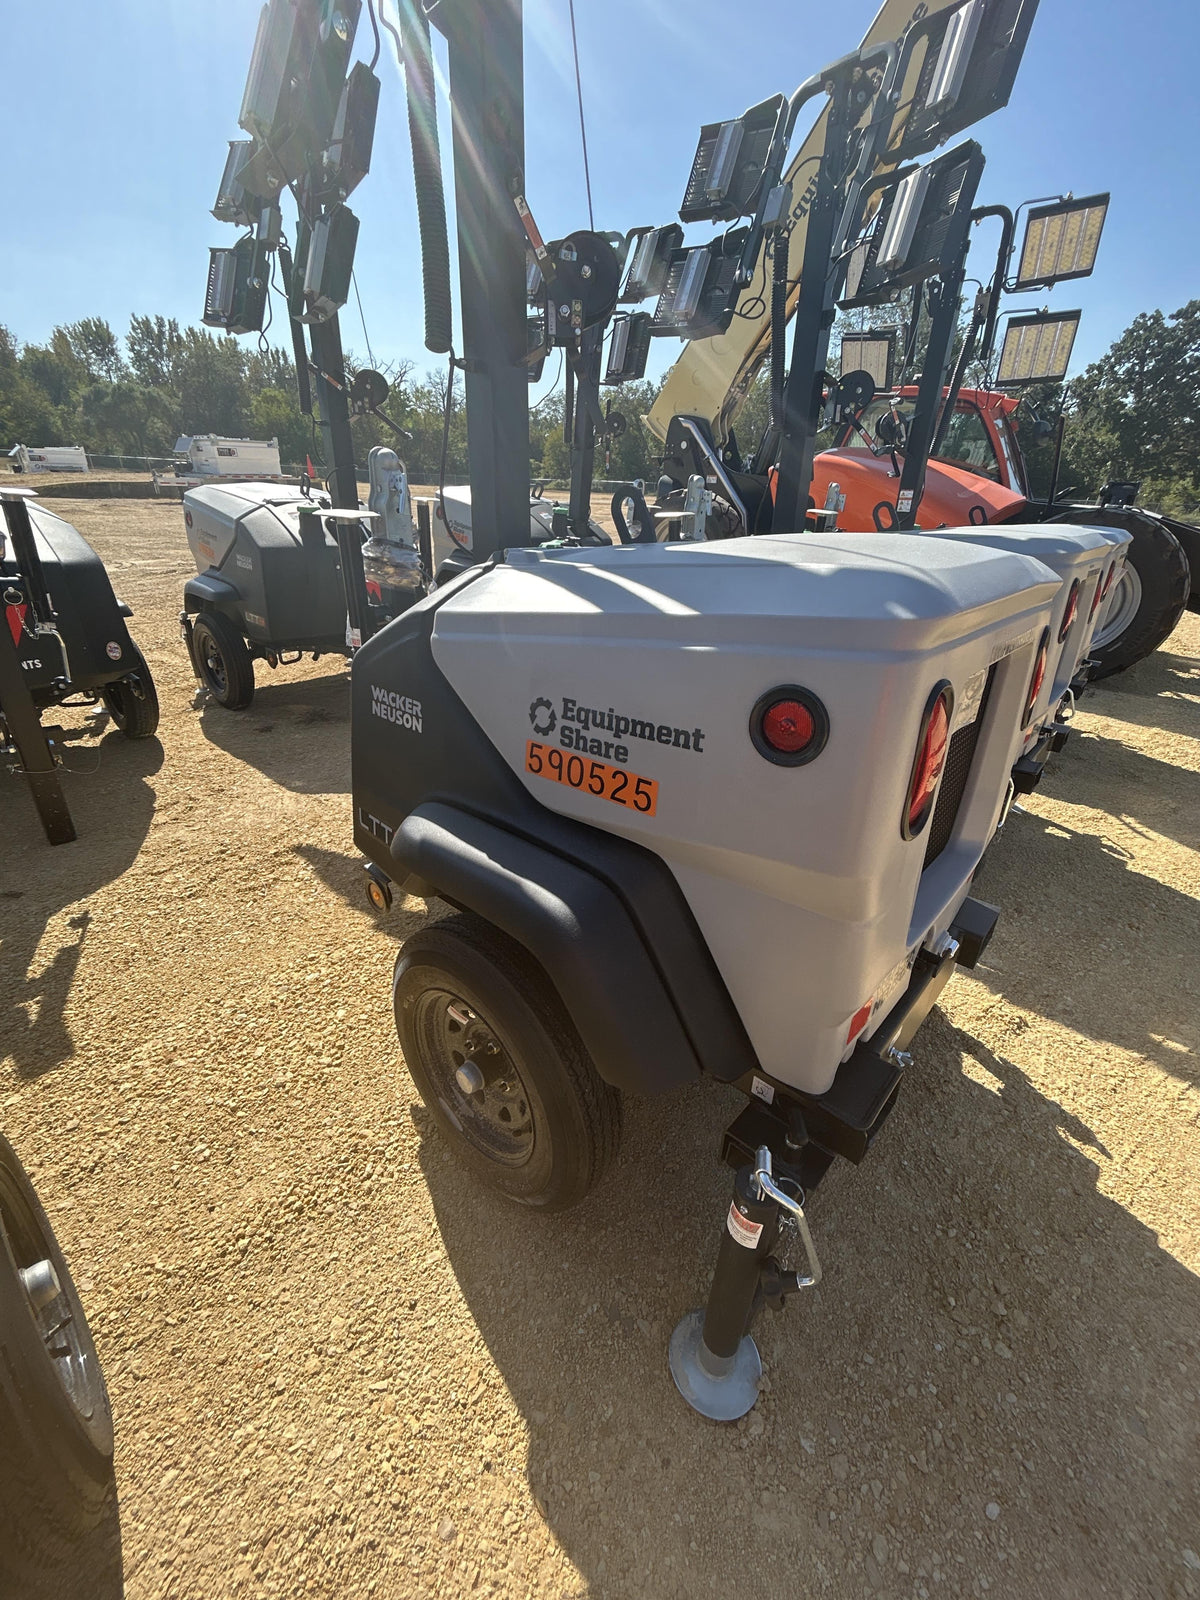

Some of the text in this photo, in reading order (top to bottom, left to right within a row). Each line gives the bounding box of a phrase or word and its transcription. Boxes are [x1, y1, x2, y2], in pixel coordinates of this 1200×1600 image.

[371, 685, 422, 717] WACKER
[372, 700, 422, 733] NEUSON
[560, 725, 629, 763] Share
[561, 698, 705, 753] Equipment
[528, 742, 652, 812] 590525
[359, 807, 396, 845] LTT
